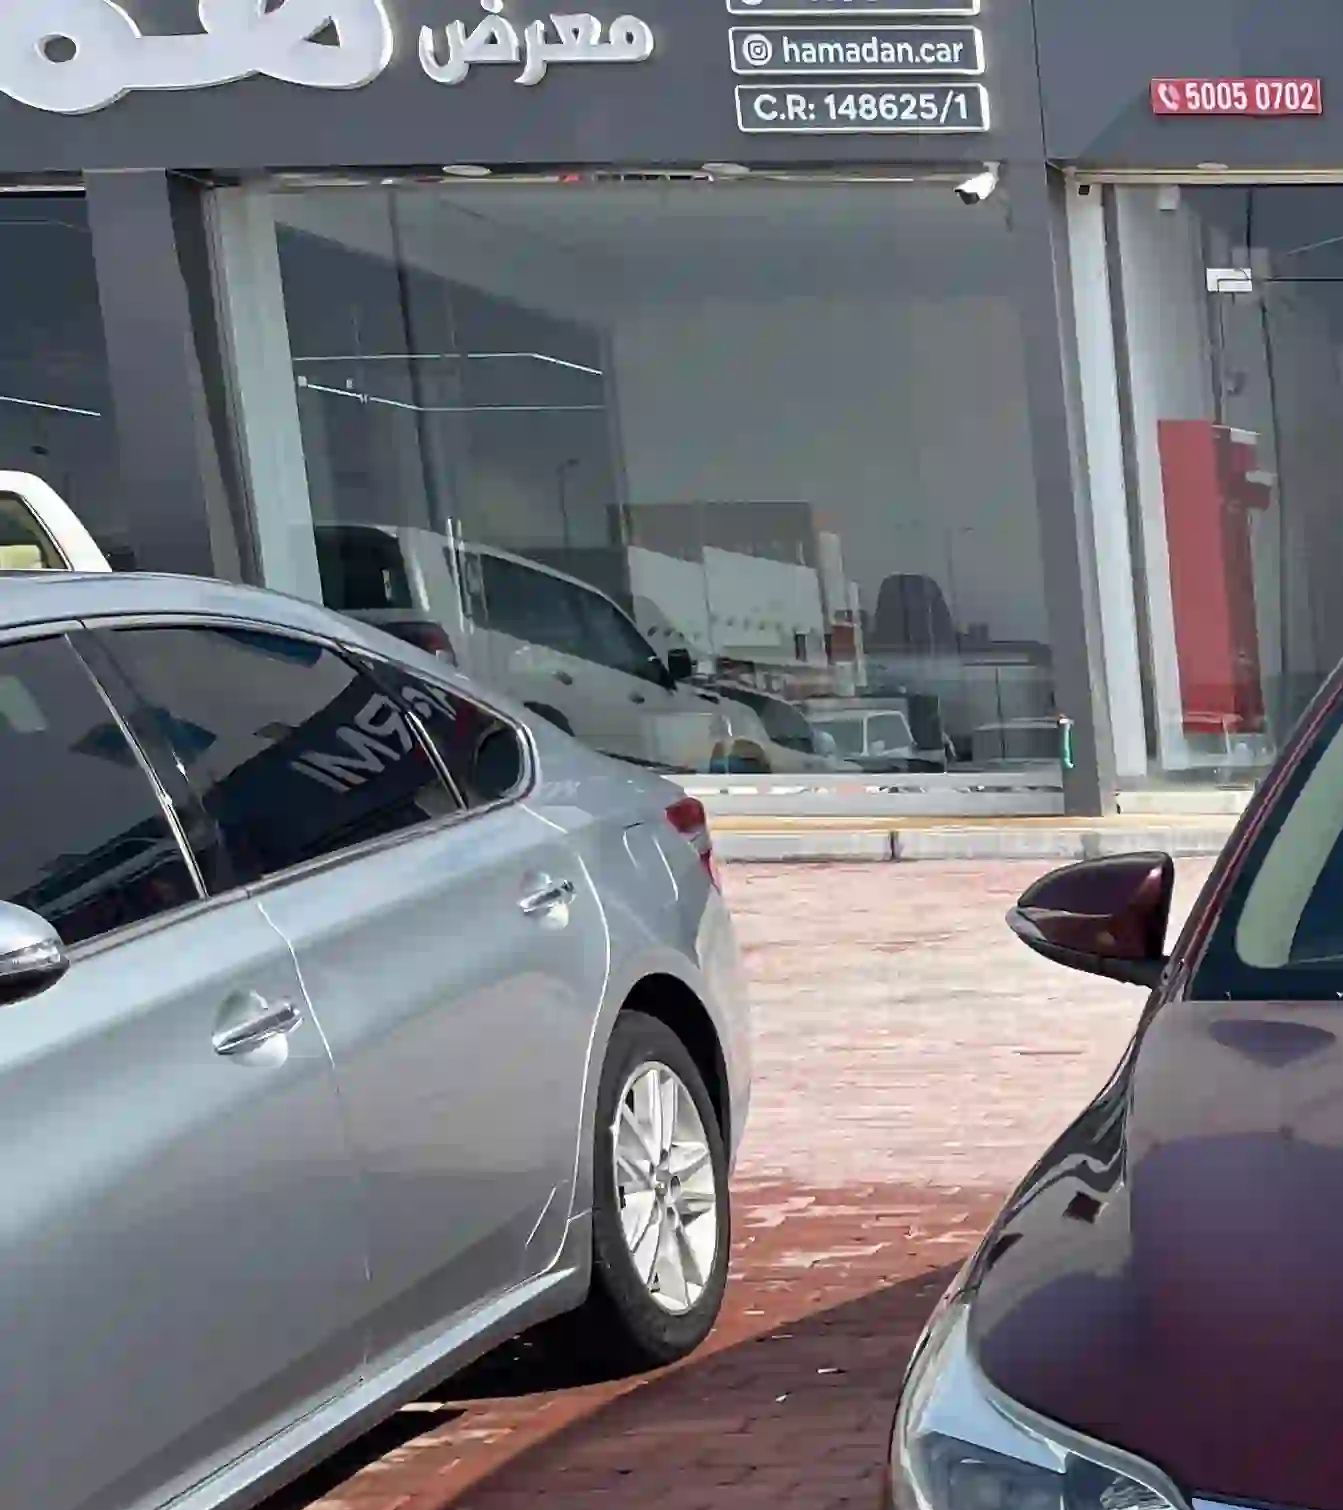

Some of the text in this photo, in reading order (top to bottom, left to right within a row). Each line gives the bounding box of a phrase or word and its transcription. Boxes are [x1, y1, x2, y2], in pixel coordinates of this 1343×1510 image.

[419, 0, 655, 86] معرض
[782, 36, 963, 63] hamadan.car
[754, 89, 968, 123] C.R: 148625/1
[1185, 82, 1317, 110] 5005 0702
